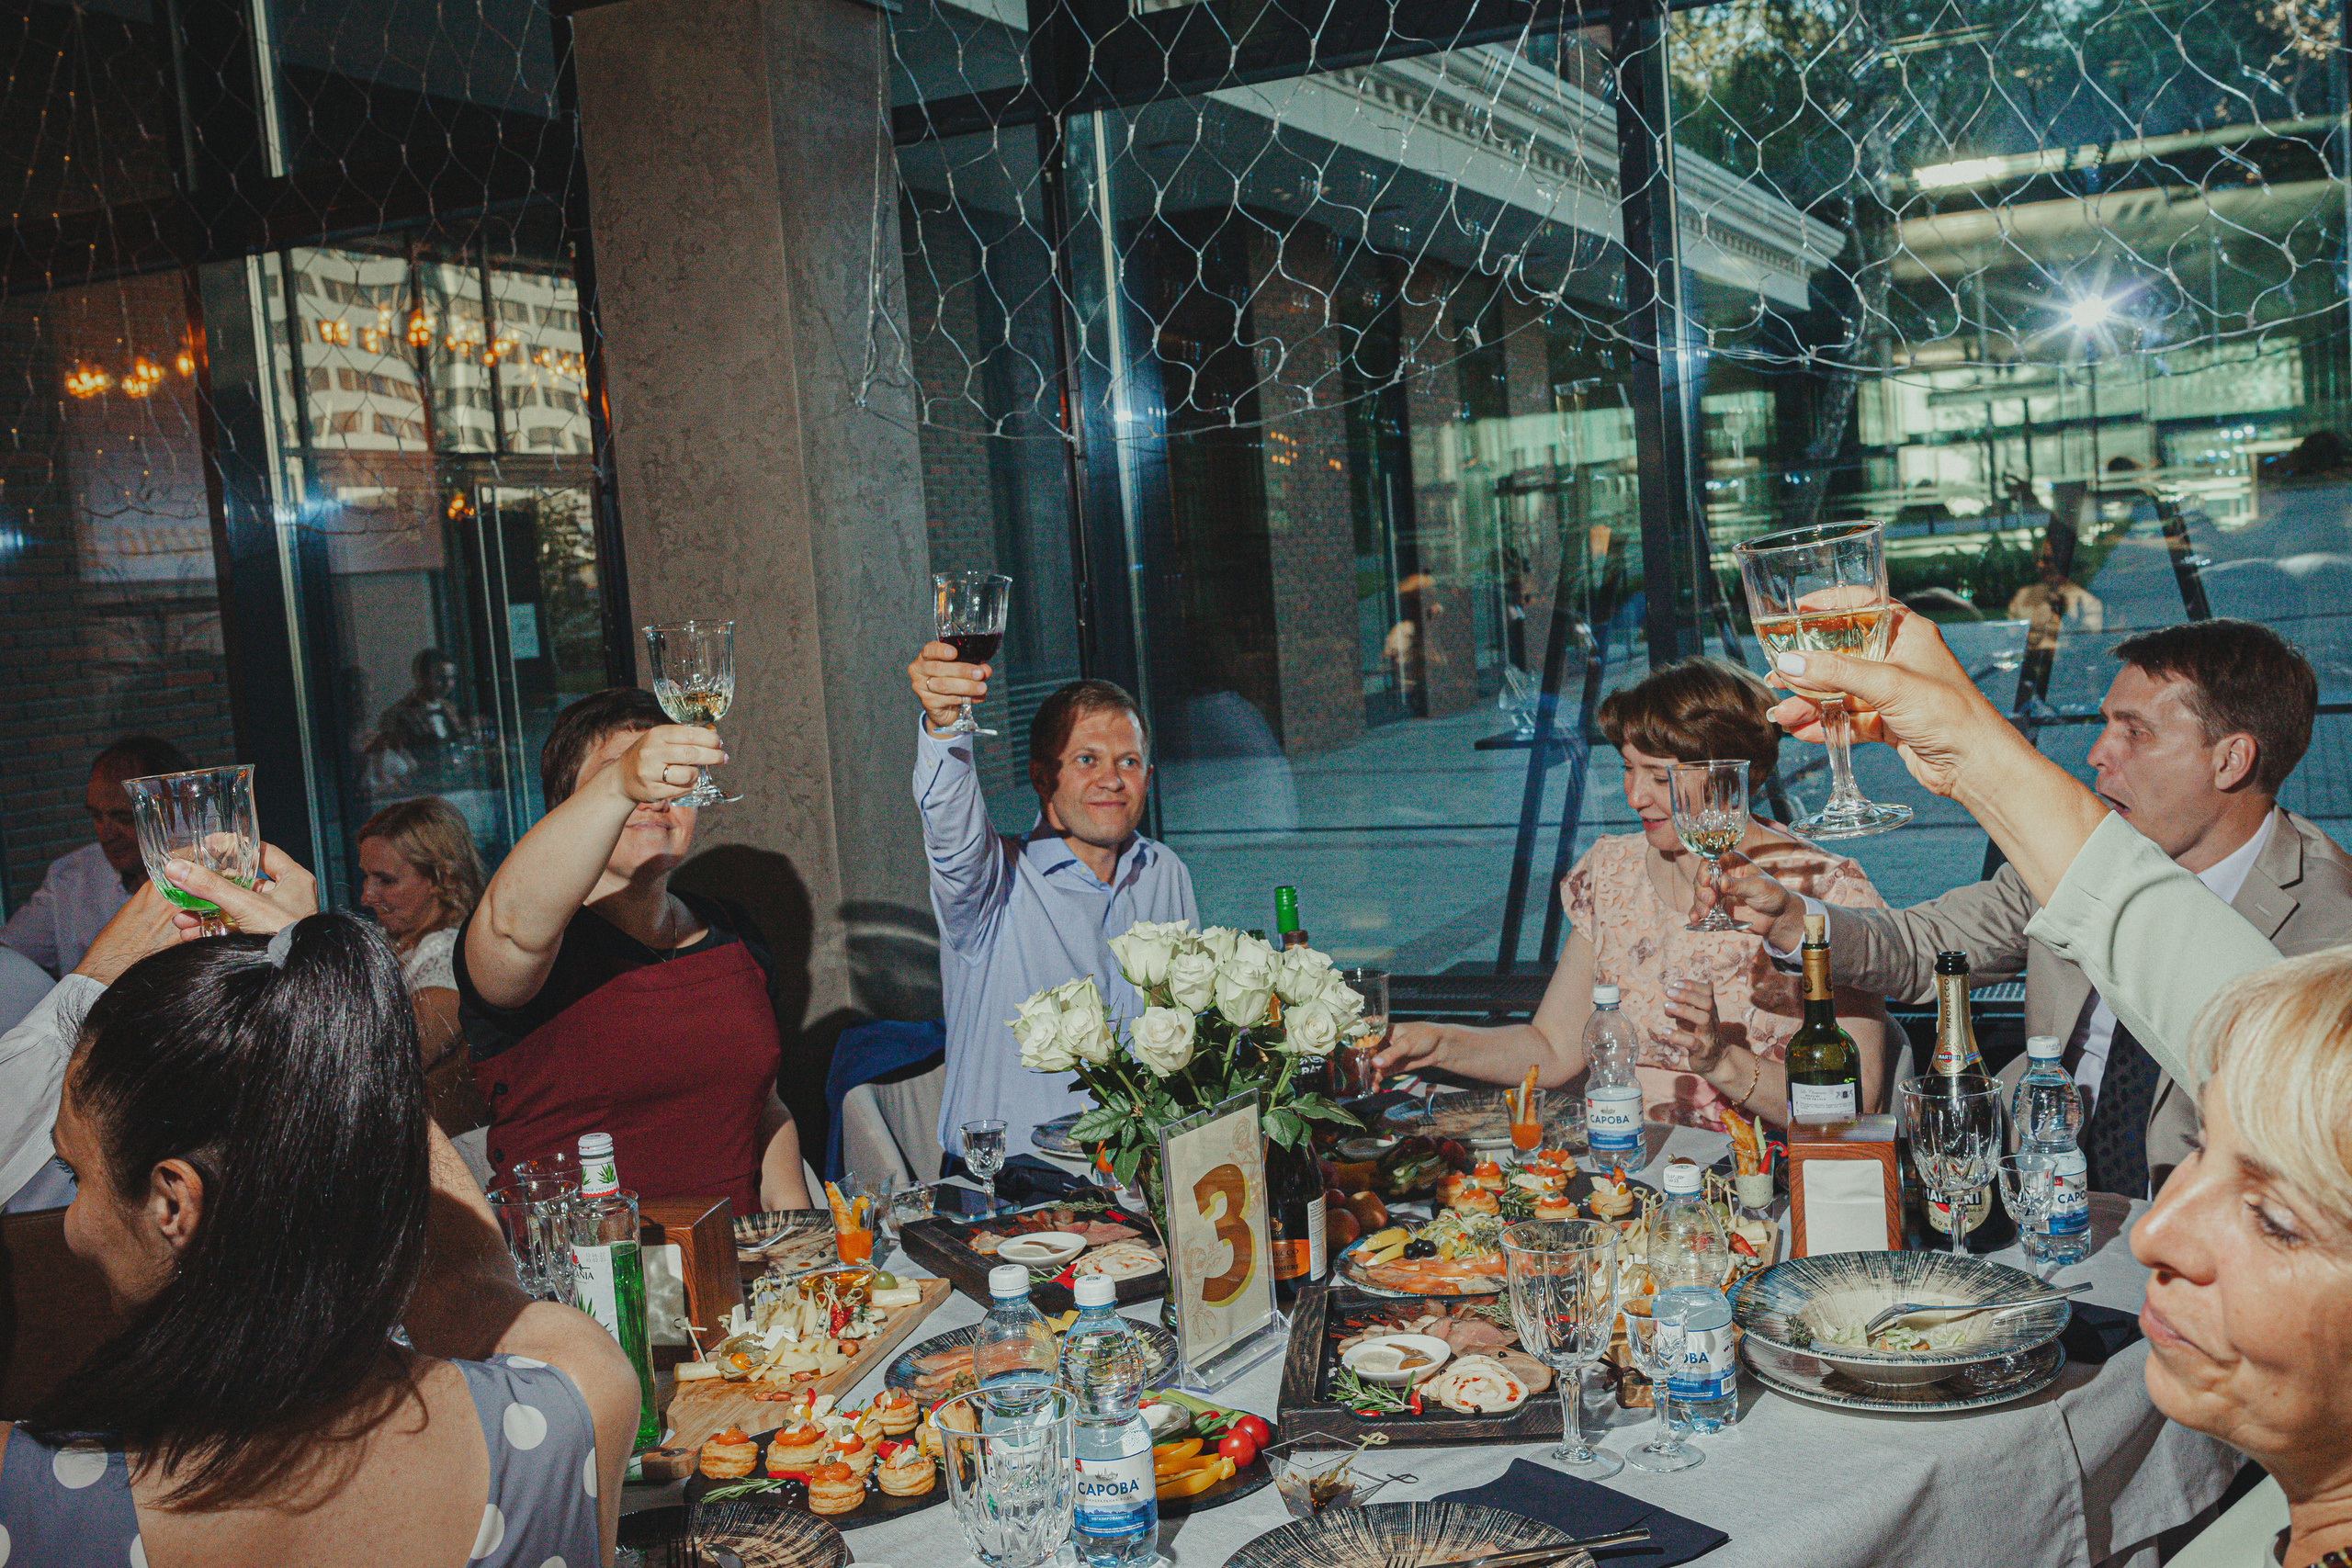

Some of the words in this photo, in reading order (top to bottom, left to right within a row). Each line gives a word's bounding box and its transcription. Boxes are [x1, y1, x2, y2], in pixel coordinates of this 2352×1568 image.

[1943, 978, 1951, 1029] PROSECCO
[1589, 1114, 1630, 1124] САРОВА
[1922, 1187, 1980, 1205] MARNI
[2057, 1190, 2086, 1204] САРО
[1193, 1163, 1257, 1308] 3
[1078, 1479, 1139, 1496] САРОВА
